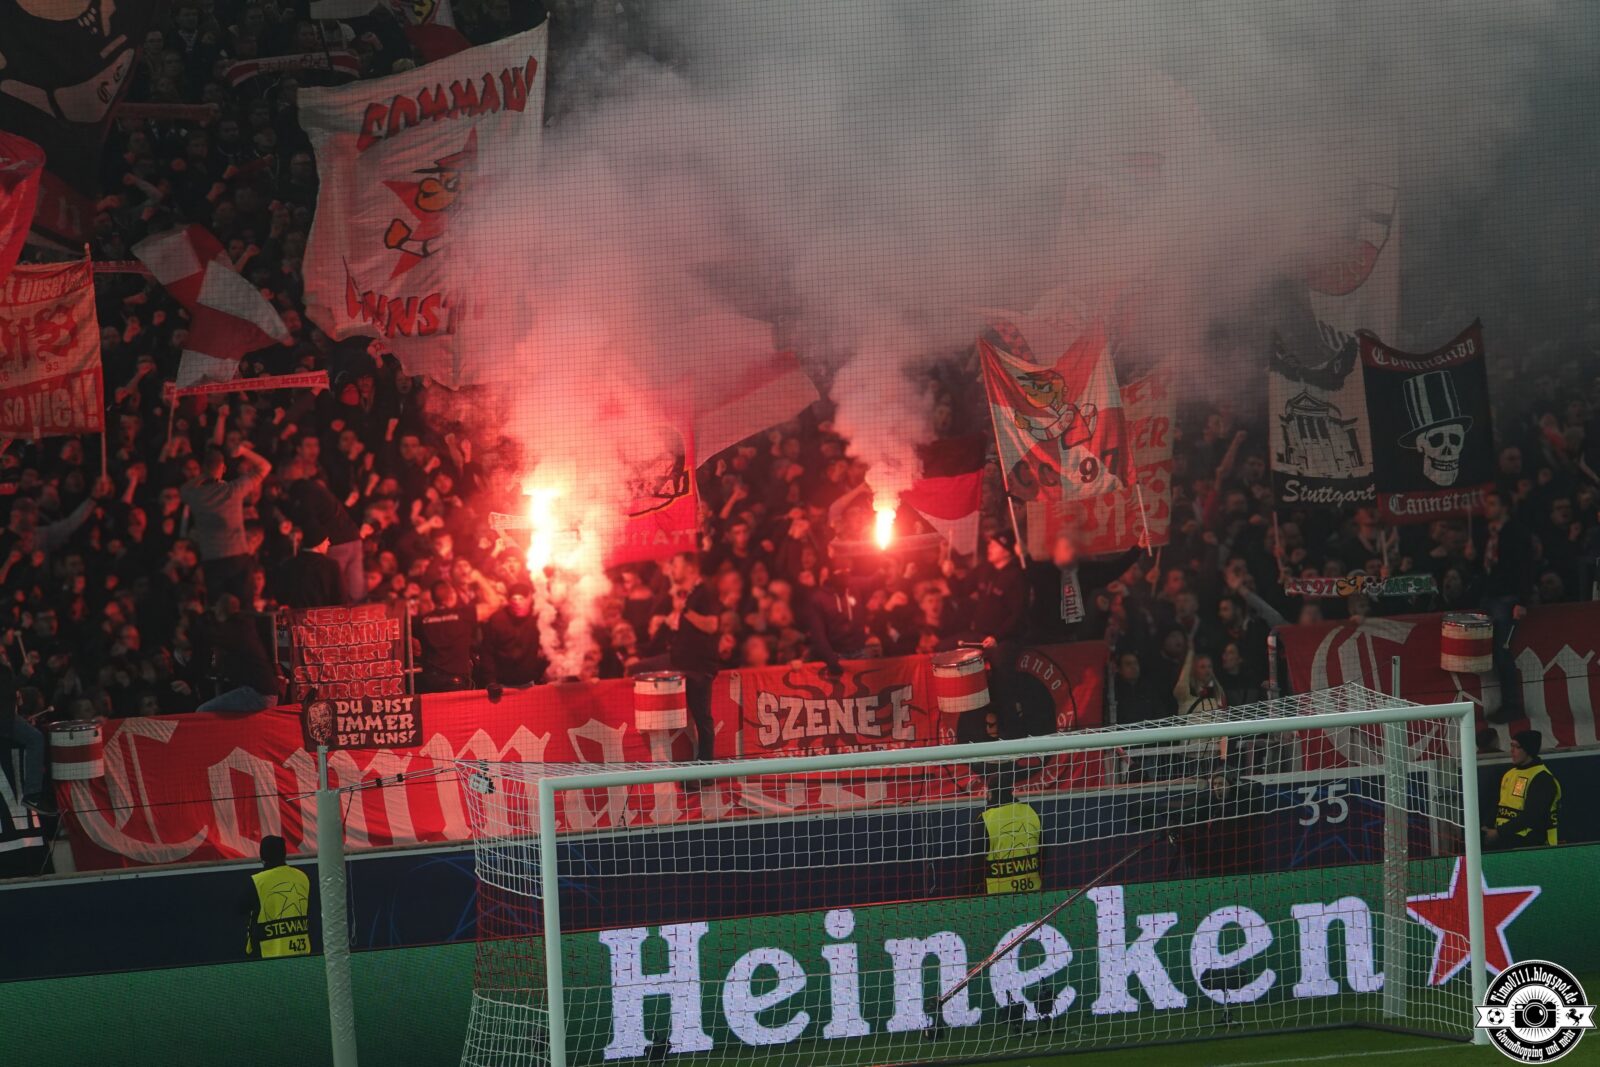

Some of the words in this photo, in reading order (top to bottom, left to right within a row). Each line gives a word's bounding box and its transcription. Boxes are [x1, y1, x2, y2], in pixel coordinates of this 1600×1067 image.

[1281, 479, 1377, 508] Stuttgart
[1388, 488, 1486, 516] Cannstatt
[303, 604, 388, 626] JEDER
[292, 618, 401, 647] VERBANNTE
[303, 641, 393, 665] KEHRT
[1021, 655, 1062, 691] ando
[335, 699, 364, 715] DU
[372, 697, 414, 714] BIST
[757, 690, 882, 747] SZENE
[336, 713, 415, 732] IMMER
[338, 732, 367, 746] BEI
[373, 730, 417, 746] UNS!
[1297, 783, 1349, 826] 35
[1010, 878, 1034, 895] 986
[288, 938, 307, 952] 423
[598, 884, 1385, 1060] Heineken
